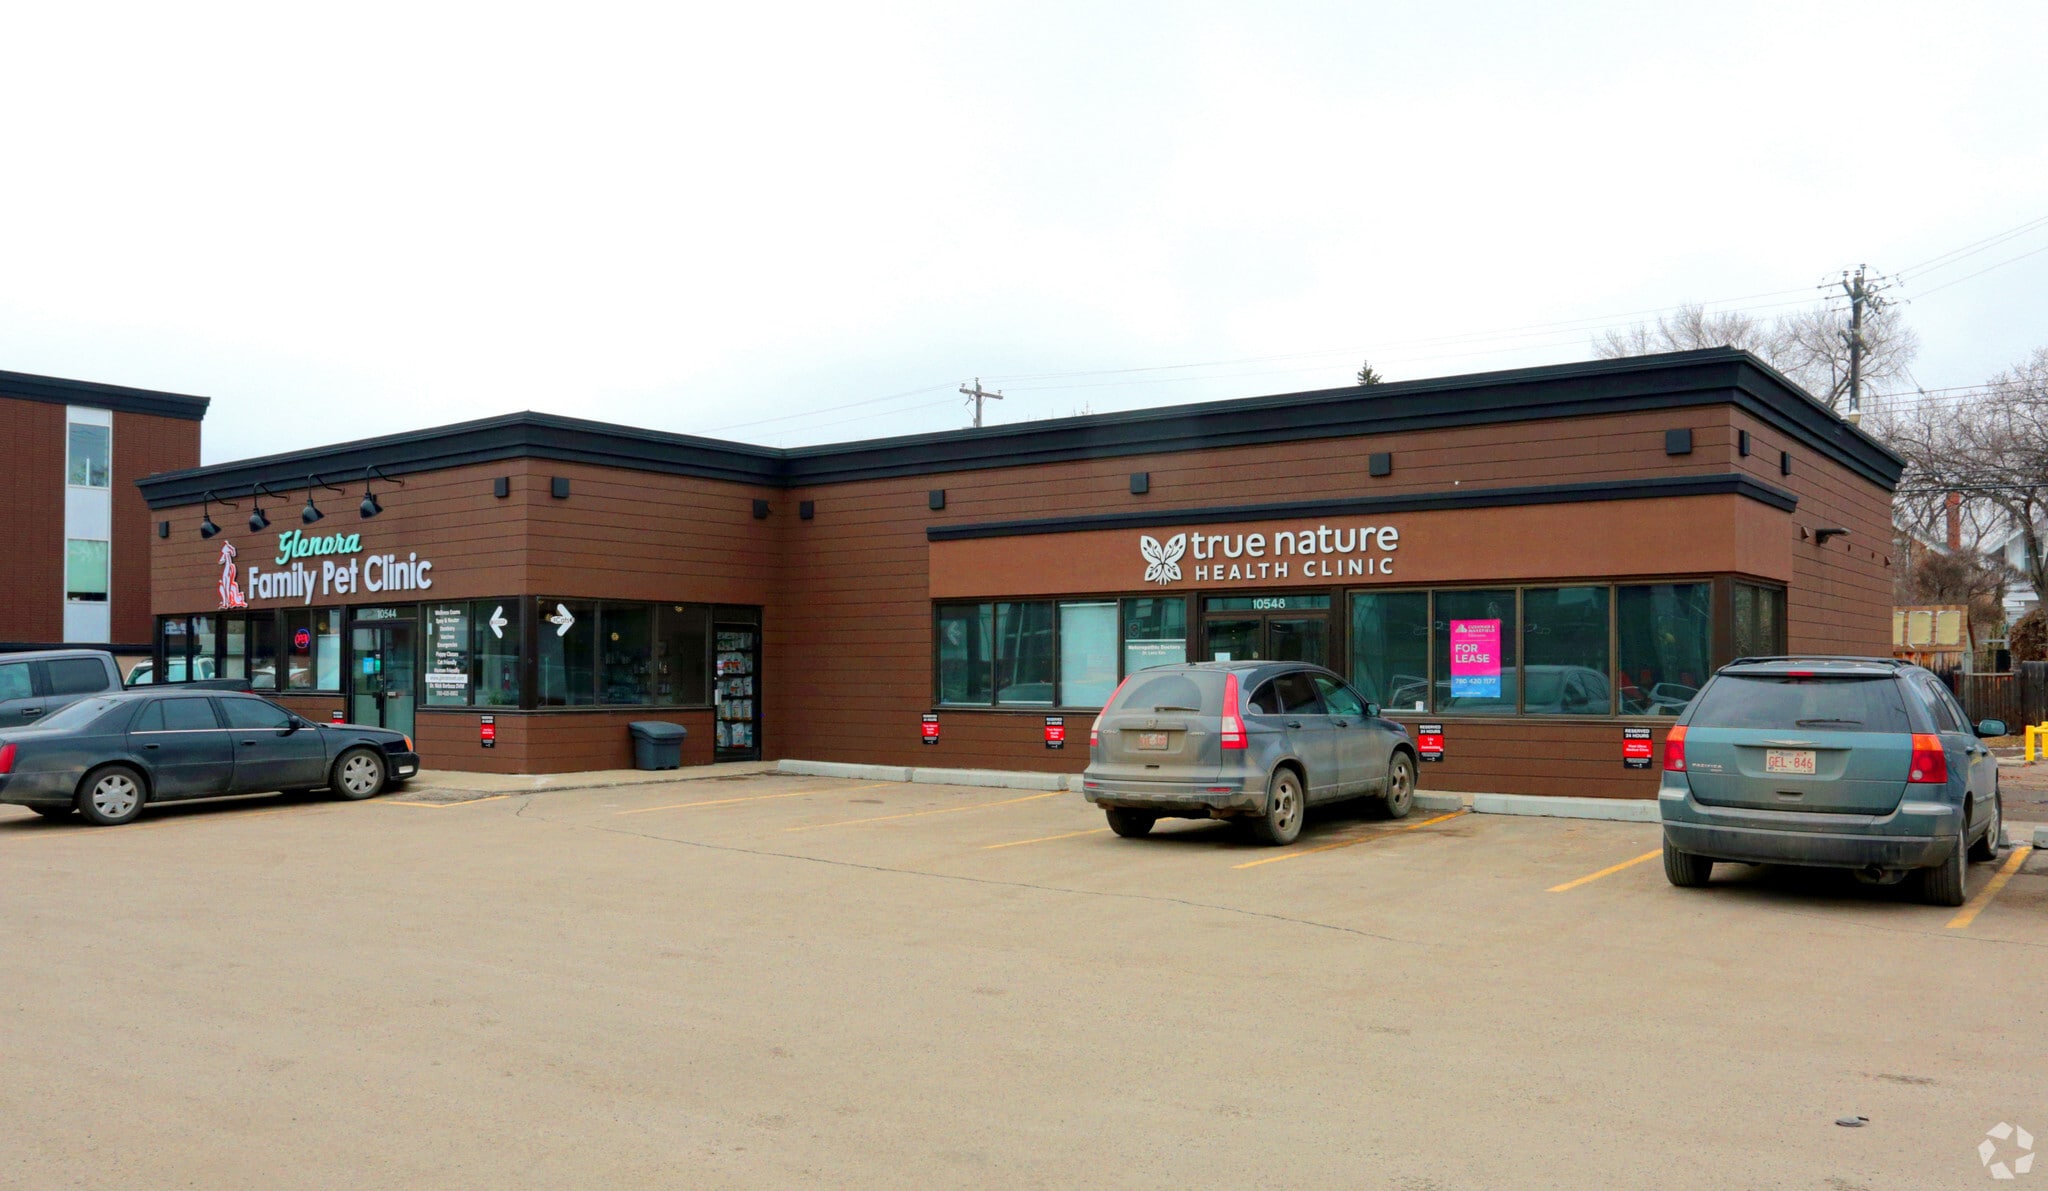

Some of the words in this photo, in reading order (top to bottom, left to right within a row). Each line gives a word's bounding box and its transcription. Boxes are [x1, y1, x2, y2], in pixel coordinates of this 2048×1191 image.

[275, 529, 363, 565] Glenora
[1191, 531, 1266, 560] true
[1275, 524, 1399, 557] nature
[1195, 561, 1289, 582] HEALTH
[1303, 557, 1394, 578] CLINIC
[249, 562, 317, 605] Family
[322, 558, 358, 596] Pet
[364, 551, 432, 593] Clinic
[1253, 598, 1286, 609] 10548
[377, 608, 397, 619] 10544
[296, 633, 308, 644] OPEN
[1455, 643, 1478, 653] FOR
[1455, 654, 1490, 664] LEASE
